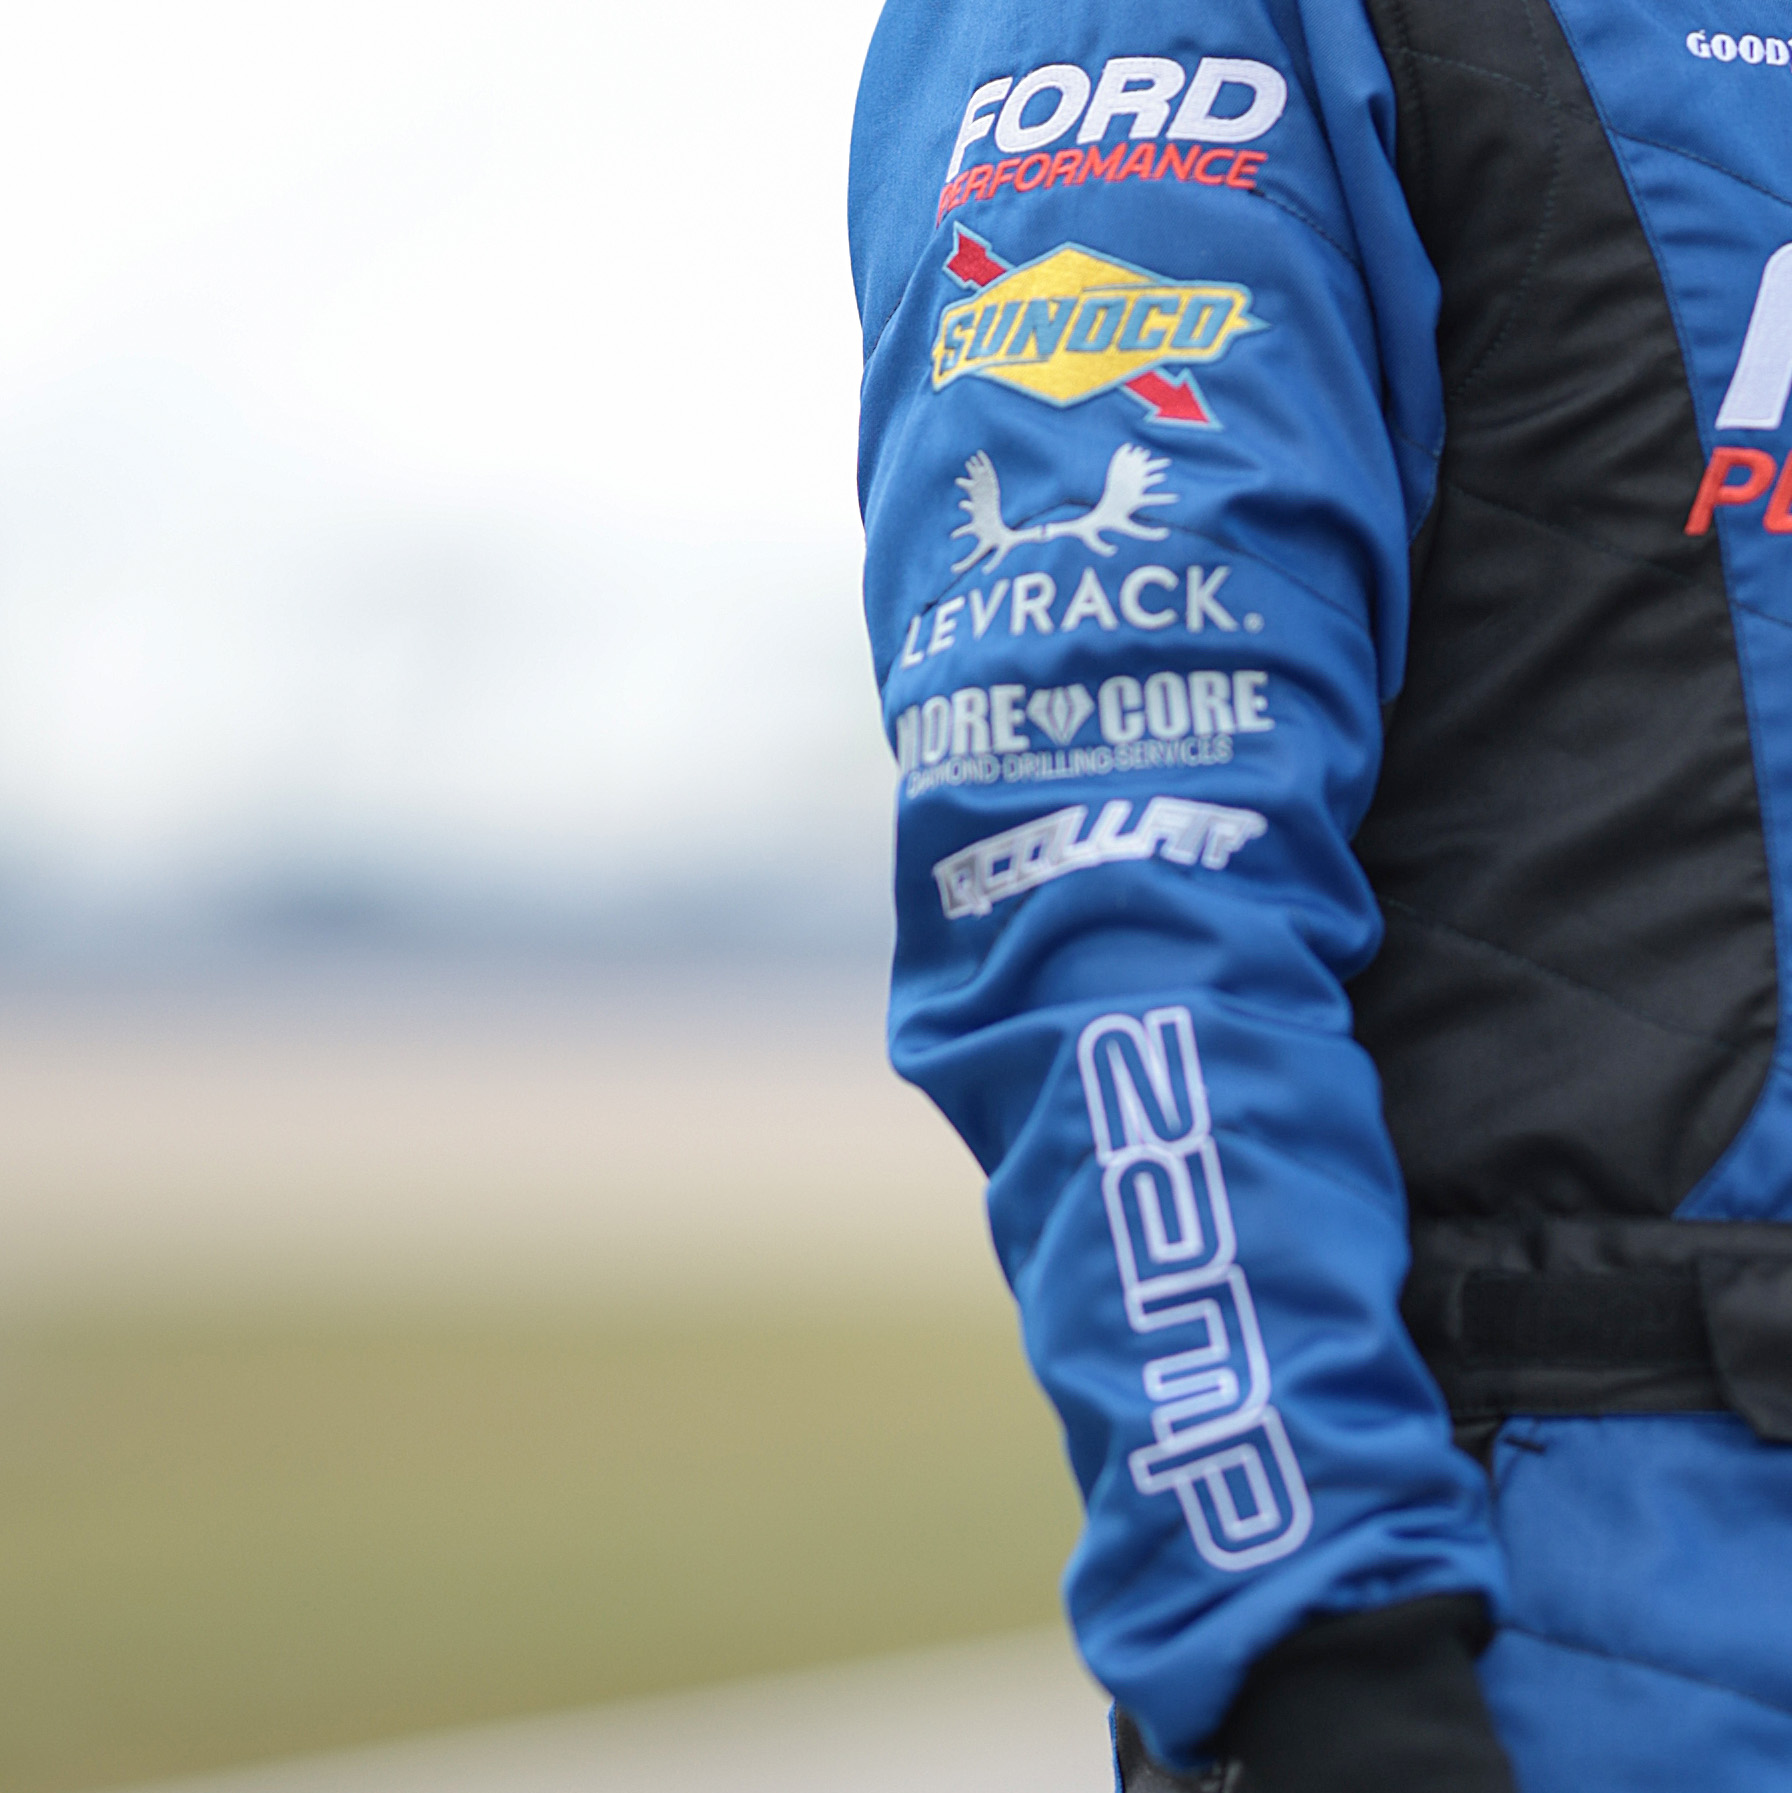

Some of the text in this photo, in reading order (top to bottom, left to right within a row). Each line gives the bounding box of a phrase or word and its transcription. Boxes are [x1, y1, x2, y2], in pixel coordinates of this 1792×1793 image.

[945, 56, 1288, 183] FORD
[936, 142, 1268, 229] PERFORMANCE
[942, 294, 1236, 372] SUNOCO
[1098, 670, 1277, 746] CORE
[1077, 1005, 1314, 1571] zamp
